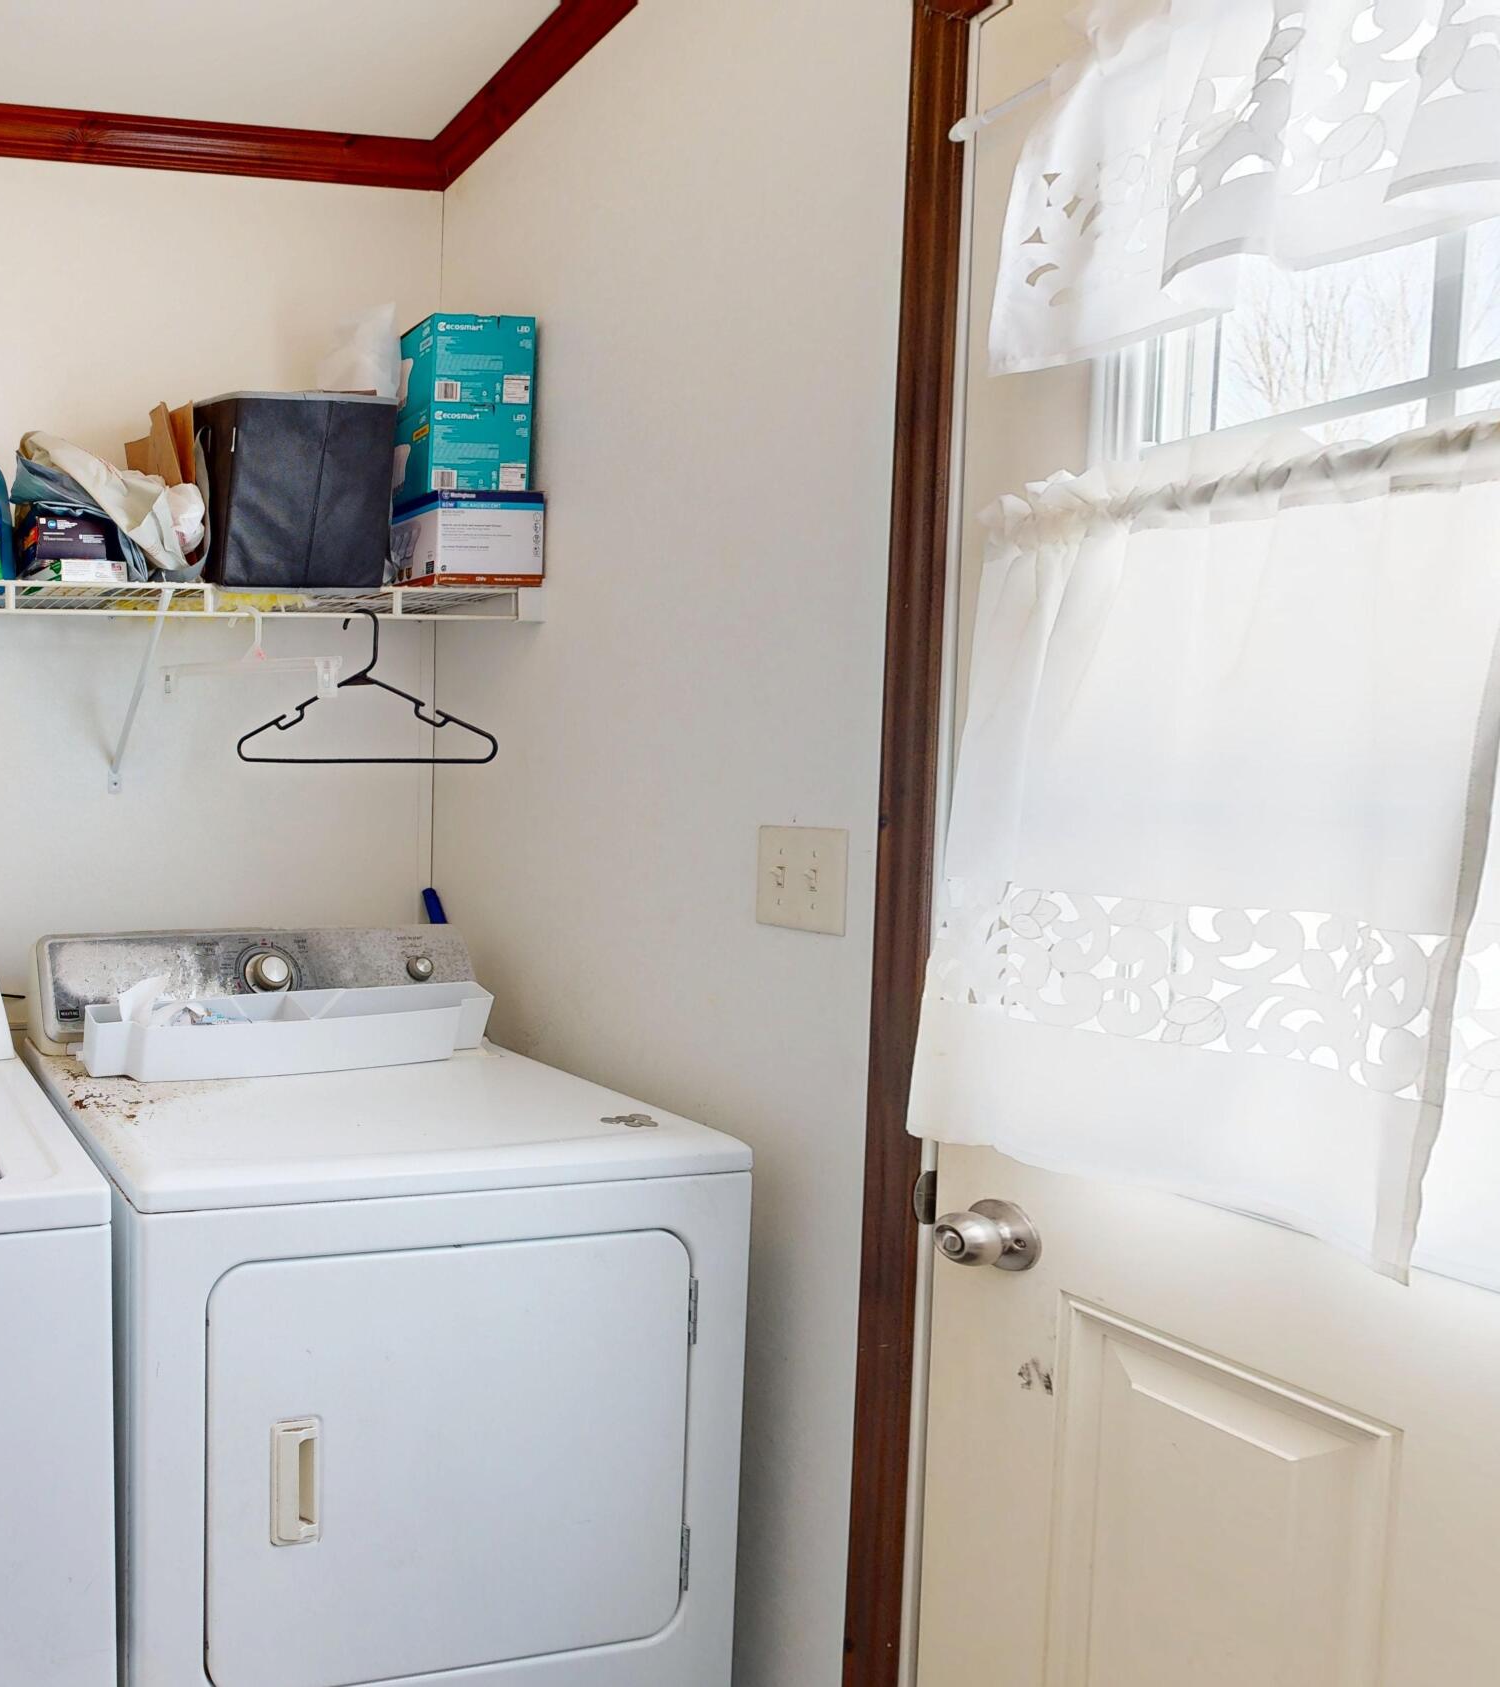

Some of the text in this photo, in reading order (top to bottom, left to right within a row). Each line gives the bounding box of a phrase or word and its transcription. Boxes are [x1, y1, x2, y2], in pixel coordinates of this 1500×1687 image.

[516, 325, 531, 333] LED
[442, 412, 480, 420] ecosmart
[512, 414, 527, 422] LED
